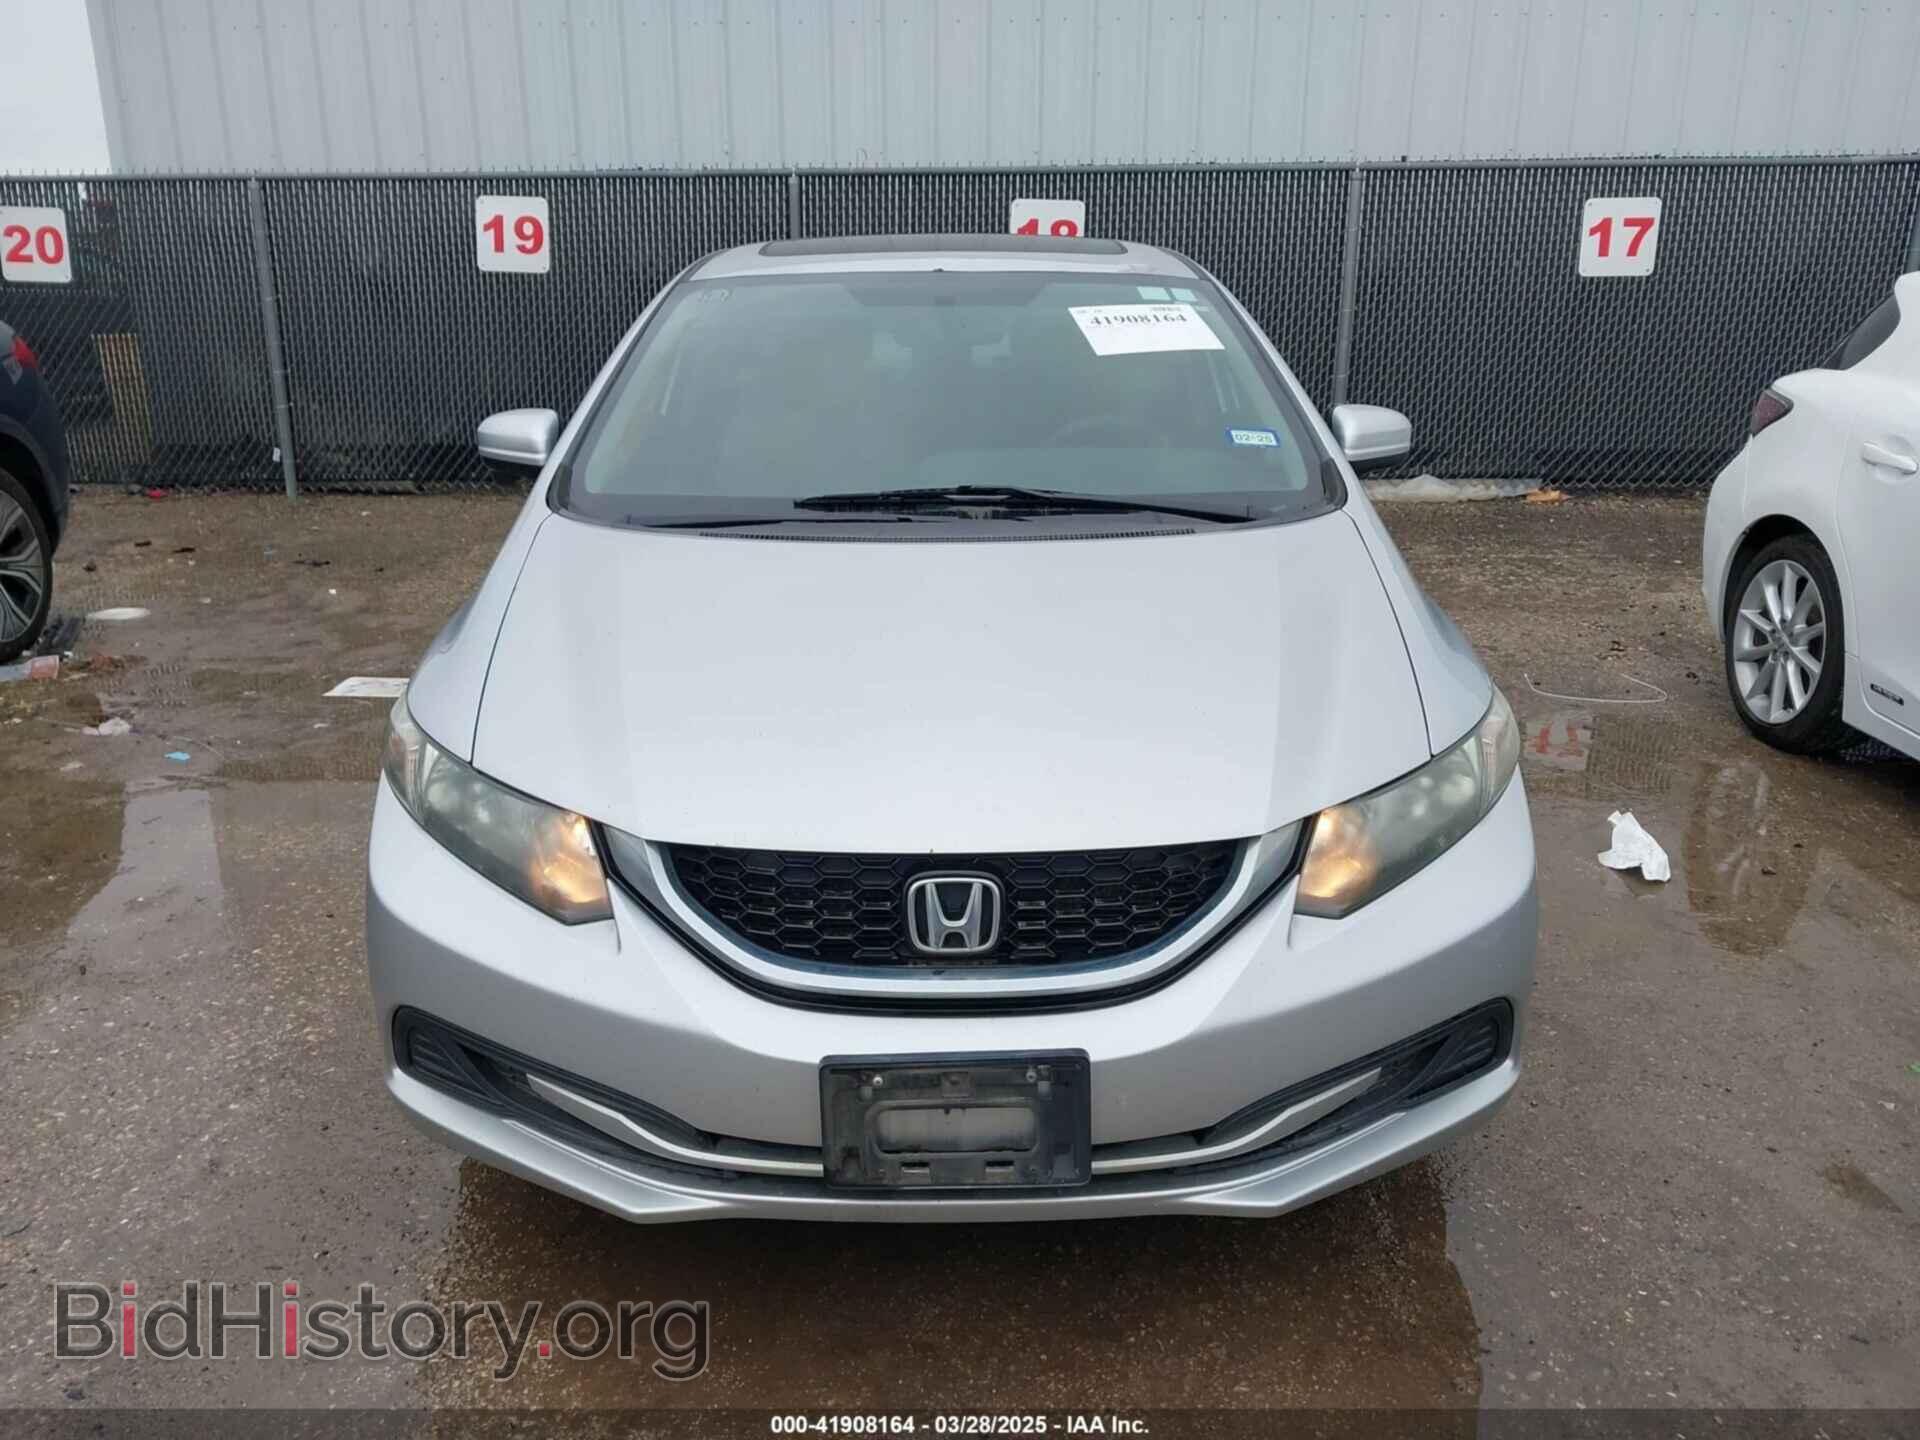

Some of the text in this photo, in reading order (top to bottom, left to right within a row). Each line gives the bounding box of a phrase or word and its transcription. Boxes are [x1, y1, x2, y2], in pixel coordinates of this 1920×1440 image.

[3, 224, 64, 265] 20
[483, 214, 544, 255] 19
[1588, 217, 1655, 257] 17
[1089, 313, 1188, 326] 41908164
